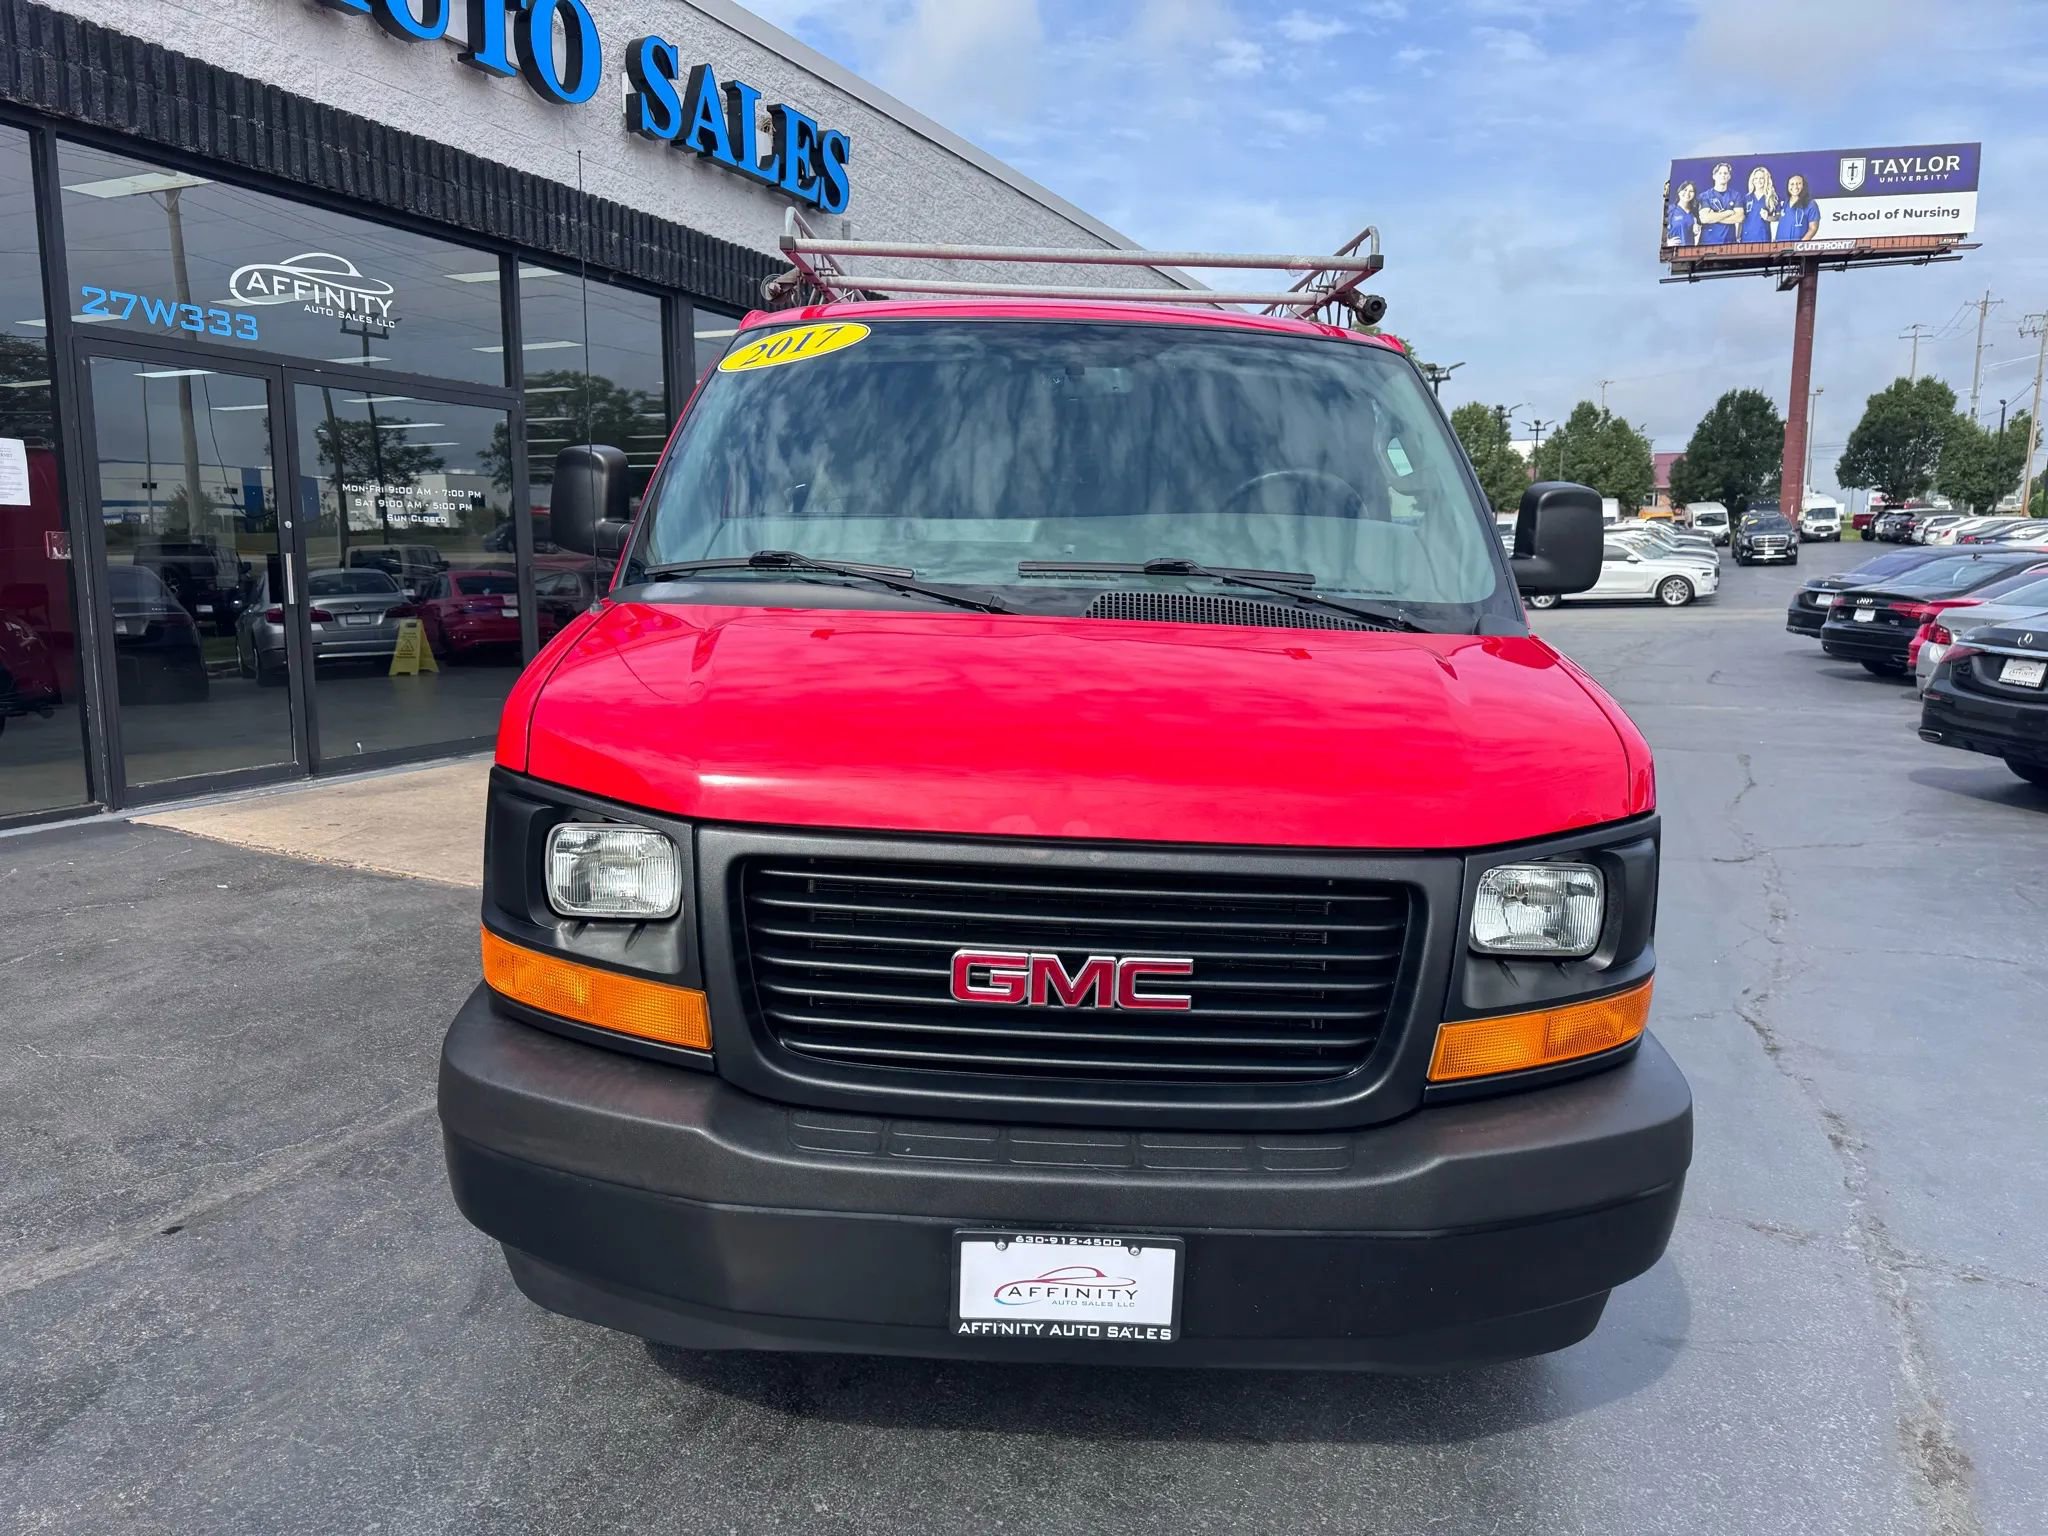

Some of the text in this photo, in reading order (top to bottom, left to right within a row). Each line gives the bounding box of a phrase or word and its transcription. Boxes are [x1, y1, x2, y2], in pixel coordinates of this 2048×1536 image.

[337, 0, 850, 214] TO SALES
[1871, 155, 1960, 175] TAYLOR
[1879, 174, 1949, 183] UNIVERSITY
[1832, 206, 1960, 221] School of Nursing
[246, 271, 393, 318] AFFINITY
[81, 286, 259, 340] 27W333
[304, 304, 395, 328] AUTO SALES LLC
[741, 326, 844, 367] 2017
[389, 487, 413, 495] 9:00
[417, 488, 431, 496] AM
[442, 489, 464, 498] 7:00
[468, 490, 481, 498] PM
[378, 499, 403, 508] 9:00
[407, 500, 422, 509] AM
[433, 502, 456, 510] 5:00
[459, 503, 473, 511] PM
[951, 949, 1194, 1010] GMC
[1016, 1235, 1122, 1247] 630-912-4500
[1008, 1286, 1138, 1300] AFFINITY
[958, 1322, 1172, 1341] AFFINITY AUTO SALES
